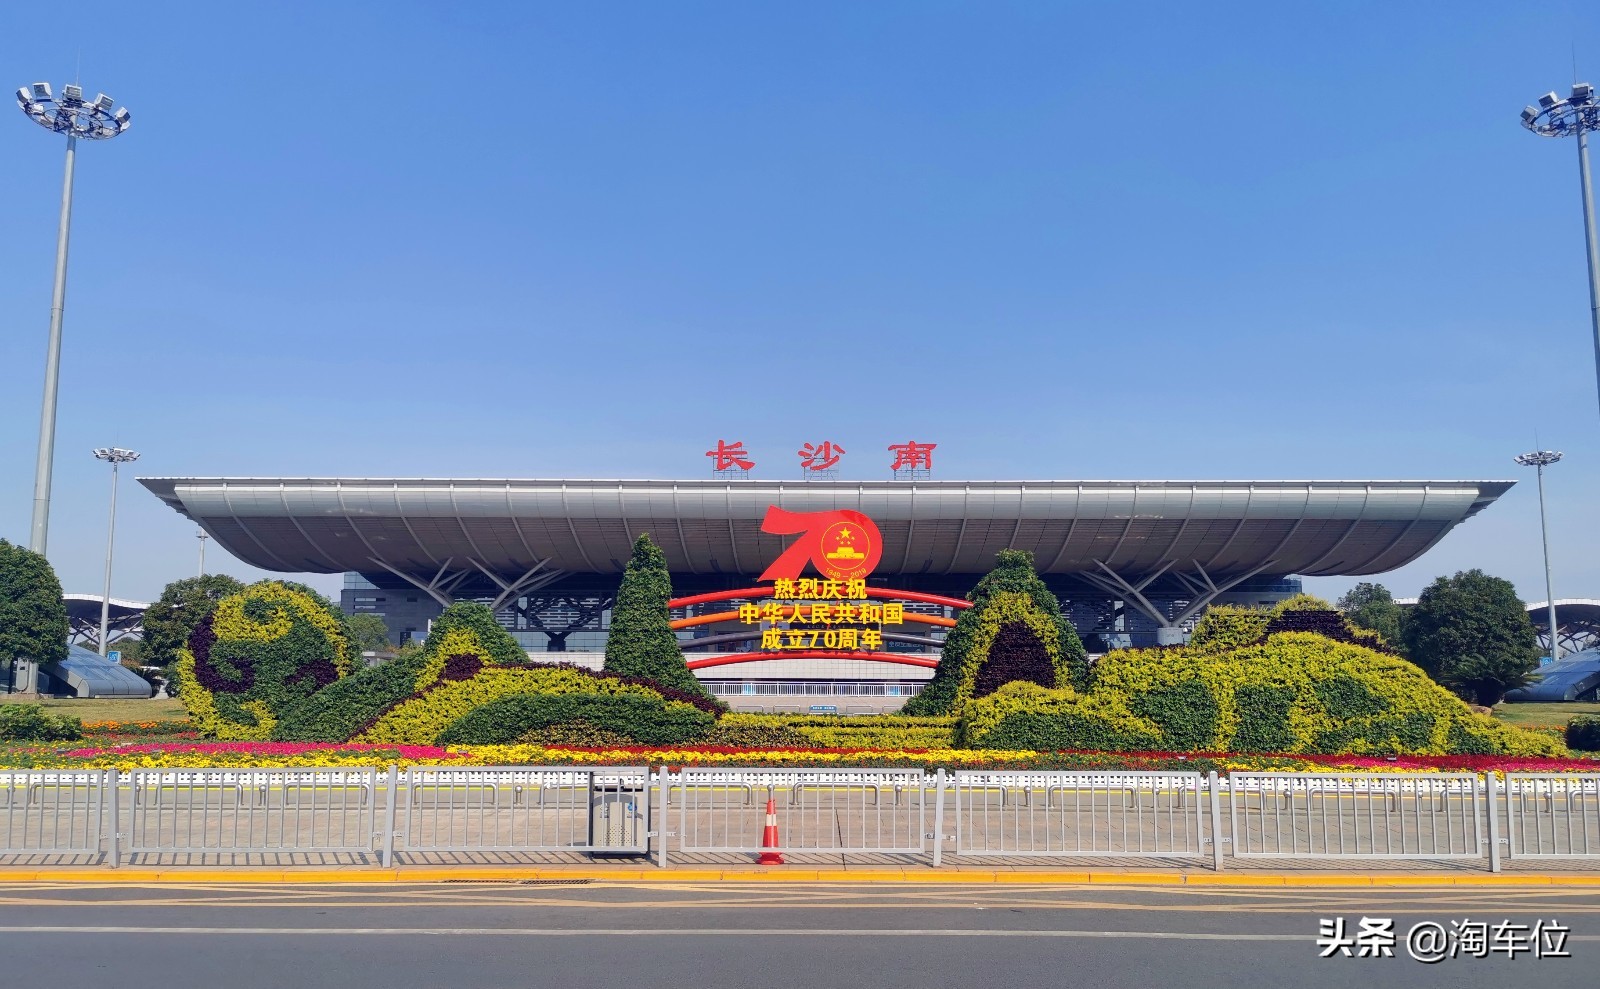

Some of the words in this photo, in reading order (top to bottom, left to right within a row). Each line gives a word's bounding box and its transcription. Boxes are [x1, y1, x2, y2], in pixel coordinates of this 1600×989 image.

[705, 439, 937, 471] 长沙南
[773, 578, 867, 600] 热烈庆祝
[739, 602, 903, 625] 中华人民共和国
[760, 627, 883, 650] 成立70周年
